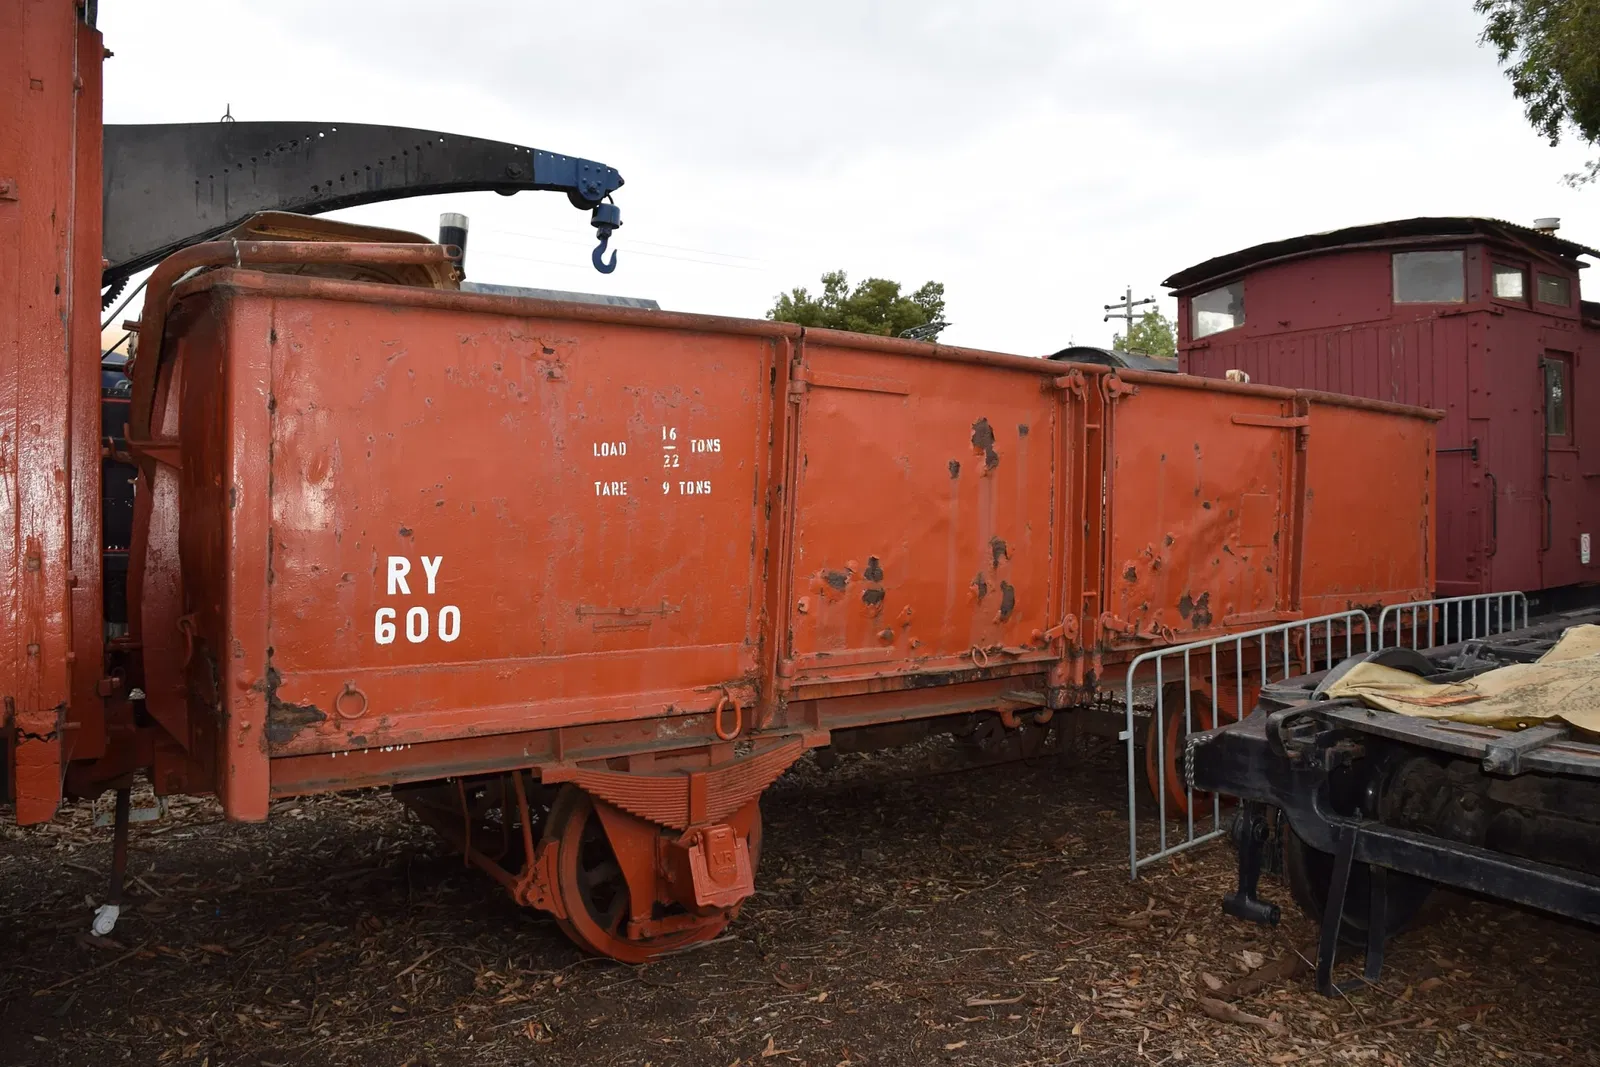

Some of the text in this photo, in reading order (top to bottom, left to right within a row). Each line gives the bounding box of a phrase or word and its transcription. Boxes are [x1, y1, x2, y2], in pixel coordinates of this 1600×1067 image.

[662, 425, 677, 441] 16
[593, 438, 721, 457] LOAD TONS
[663, 454, 680, 468] 22
[594, 480, 712, 497] TARE 9 TONS
[387, 555, 443, 595] RY
[374, 605, 461, 645] 600
